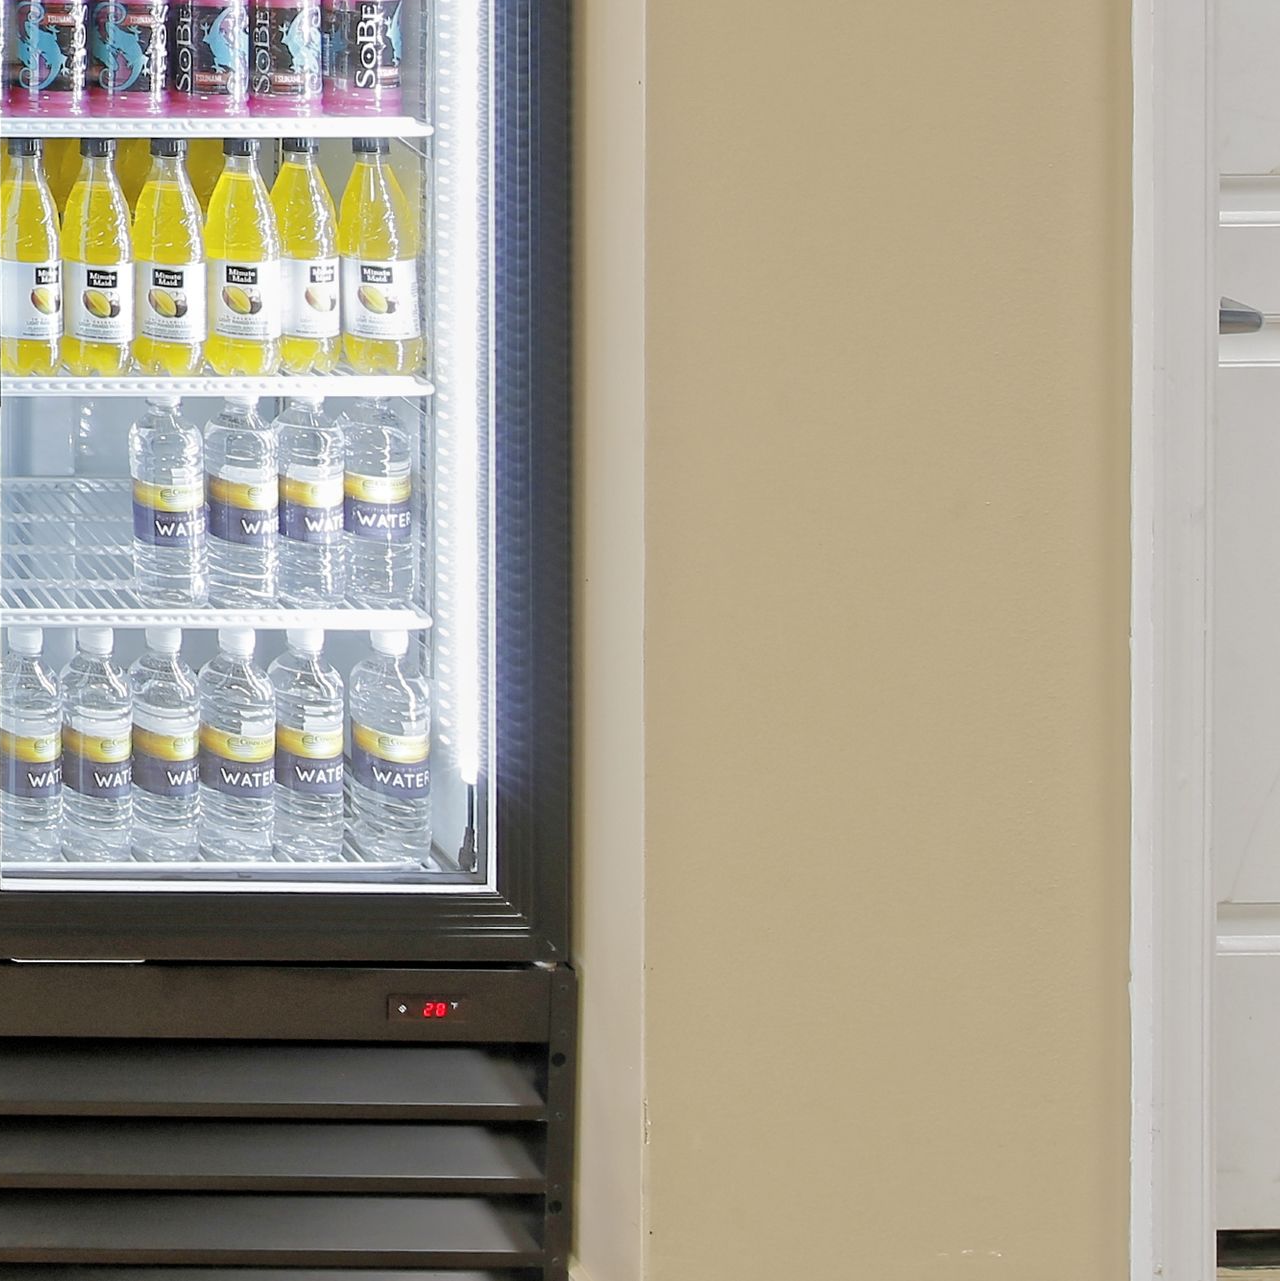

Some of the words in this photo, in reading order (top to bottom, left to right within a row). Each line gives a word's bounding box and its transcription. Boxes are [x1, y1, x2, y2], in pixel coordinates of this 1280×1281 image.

[356, 510, 411, 529] WATER
[295, 765, 343, 784] WATE
[372, 765, 430, 789] WATER
[423, 1001, 448, 1018] 28
